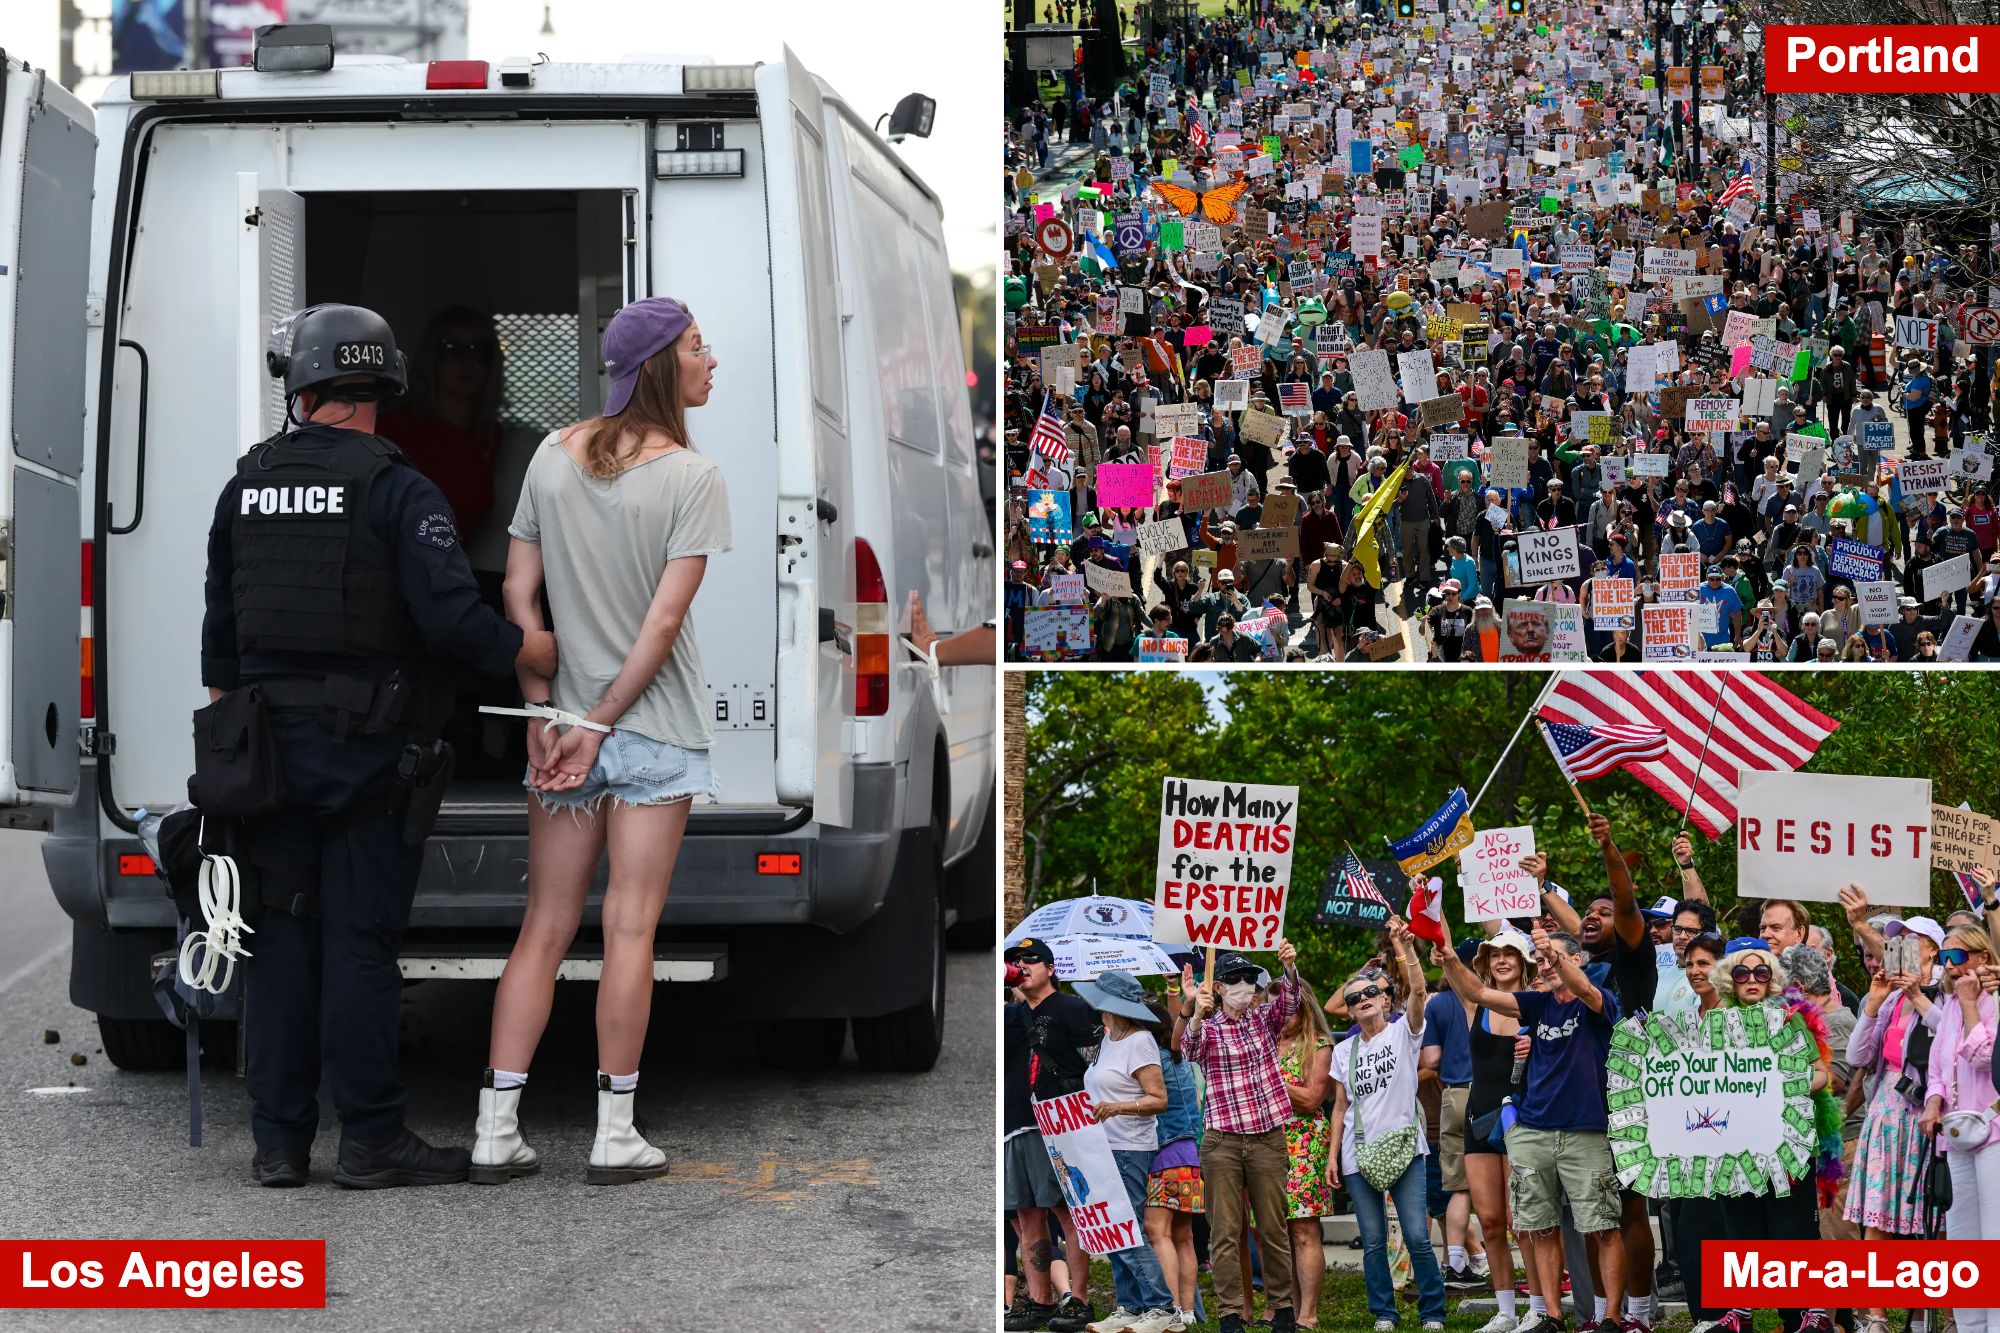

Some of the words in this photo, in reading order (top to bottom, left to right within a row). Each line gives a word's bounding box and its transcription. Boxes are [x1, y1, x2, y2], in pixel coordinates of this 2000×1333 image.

[1663, 250, 1678, 258] END
[1291, 263, 1309, 271] FIGHT
[1650, 258, 1688, 267] AMERICAN
[1210, 300, 1239, 314] Liberty
[1436, 316, 1454, 324] LIFT
[1320, 326, 1341, 334] FIGHT
[1428, 323, 1460, 334] OTHERS
[1317, 334, 1344, 342] TRUMP'S
[340, 345, 384, 364] 33413
[1318, 344, 1343, 352] AGENDA
[1694, 400, 1733, 410] REMOVE
[1699, 410, 1727, 419] THESE
[1687, 420, 1733, 431] LUNATICS!
[1869, 423, 1891, 432] STOP
[1175, 437, 1206, 449] REVOKE
[1175, 446, 1189, 458] THE
[1192, 448, 1205, 460] ICE
[1173, 458, 1204, 469] PERMIT!
[1903, 463, 1944, 477] RESIST
[1902, 474, 1949, 490] TYRANNY
[240, 486, 344, 515] POLICE
[1188, 485, 1229, 506] APATHY
[1274, 501, 1288, 510] NO
[418, 520, 428, 536] LOS
[429, 525, 451, 533] METRO
[1139, 521, 1170, 541] EVOLVE
[432, 535, 455, 547] POLICE
[1144, 533, 1181, 555] ALREADY
[1534, 535, 1559, 549] NO
[1251, 546, 1281, 554] AMERICA
[1526, 547, 1573, 564] KINGS
[1837, 541, 1880, 559] PROUDLY
[1660, 553, 1699, 564] REVOKE
[1834, 554, 1879, 571] DEFENDING
[1527, 567, 1553, 577] SINCE
[1557, 563, 1576, 573] 1776
[1662, 565, 1682, 578] THE
[1683, 564, 1699, 576] ICE
[1832, 562, 1880, 580] DEMOCRACY
[1594, 580, 1633, 590] REVOKE
[1661, 579, 1700, 589] PERMIT!
[1594, 591, 1615, 604] THE
[1617, 590, 1632, 602] ICE
[1595, 605, 1633, 615] PERMIT!
[1644, 609, 1686, 619] REVOKE
[1645, 620, 1667, 634] THE
[1669, 619, 1687, 633] ICE
[1142, 640, 1157, 653] NO
[1646, 634, 1689, 645] PERMIT!
[1166, 780, 1219, 817] How
[1222, 785, 1293, 825] Many
[1413, 821, 1439, 843] STAND
[1438, 801, 1458, 823] WITH
[1972, 819, 1989, 833] FOR
[1173, 819, 1292, 854] DEATHS
[1485, 833, 1508, 847] NO
[1740, 817, 1927, 859] RESIST
[1476, 842, 1521, 860] CONS
[1945, 843, 1975, 860] HAVE
[1171, 854, 1219, 881] for
[1229, 857, 1276, 882] the
[1488, 858, 1510, 871] NO
[1937, 857, 1955, 870] FOR
[1495, 883, 1518, 895] NO
[1164, 881, 1284, 914] EPSTEIN
[1476, 893, 1536, 916] KINGS
[1325, 900, 1353, 916] NOT
[1358, 903, 1387, 920] WAR
[1184, 913, 1280, 950] WAR?
[1374, 1056, 1397, 1075] WAY
[1645, 1055, 1680, 1075] Keep
[1681, 1052, 1718, 1074] Your
[1723, 1051, 1772, 1073] Name
[1644, 1076, 1677, 1098] Off
[1679, 1076, 1712, 1095] Our
[1714, 1077, 1767, 1098] Money!
